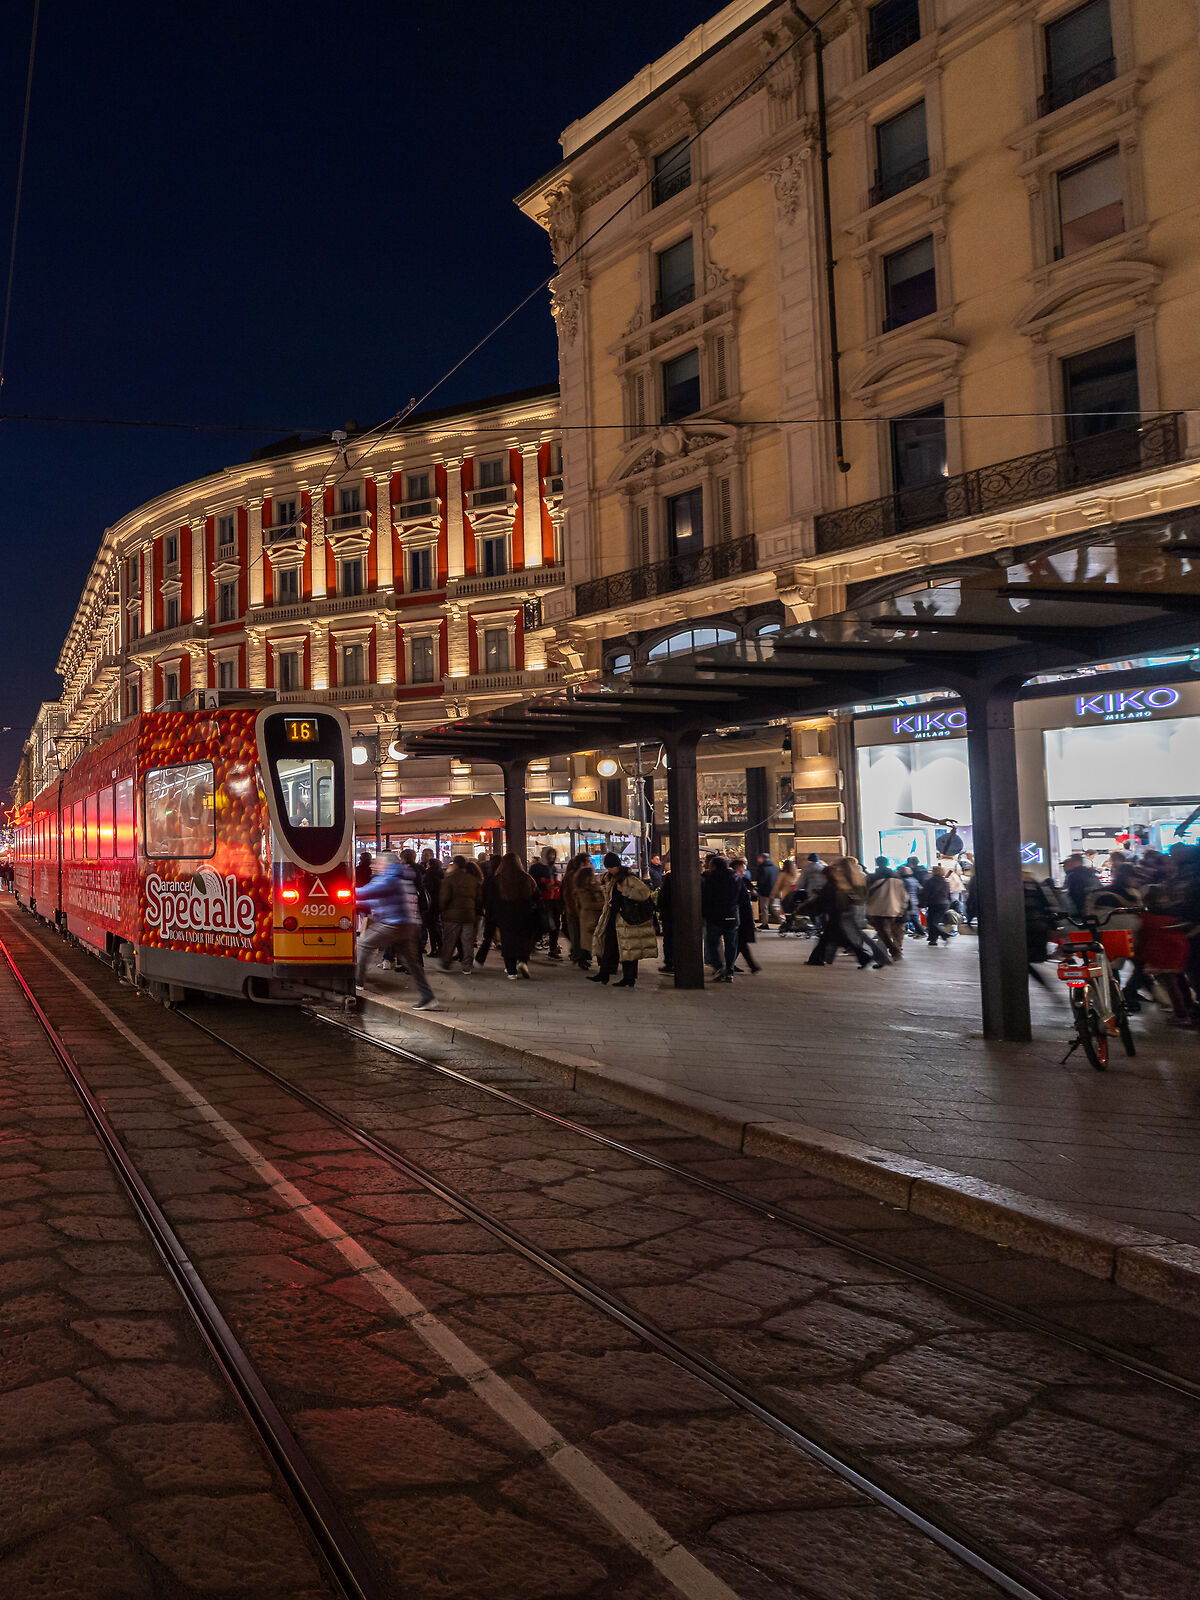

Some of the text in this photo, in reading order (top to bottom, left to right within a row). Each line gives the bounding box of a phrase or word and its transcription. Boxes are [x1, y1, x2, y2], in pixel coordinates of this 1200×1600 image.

[1076, 687, 1179, 715] KIKO
[894, 710, 968, 734] KIKO
[1104, 710, 1152, 720] MILANO
[291, 722, 310, 740] 16
[915, 730, 951, 739] MILANO
[161, 881, 191, 892] arance
[145, 873, 256, 939] Speciale
[301, 904, 336, 916] 4920
[169, 930, 253, 950] BORN UNDER THE SICILIAN SUN
